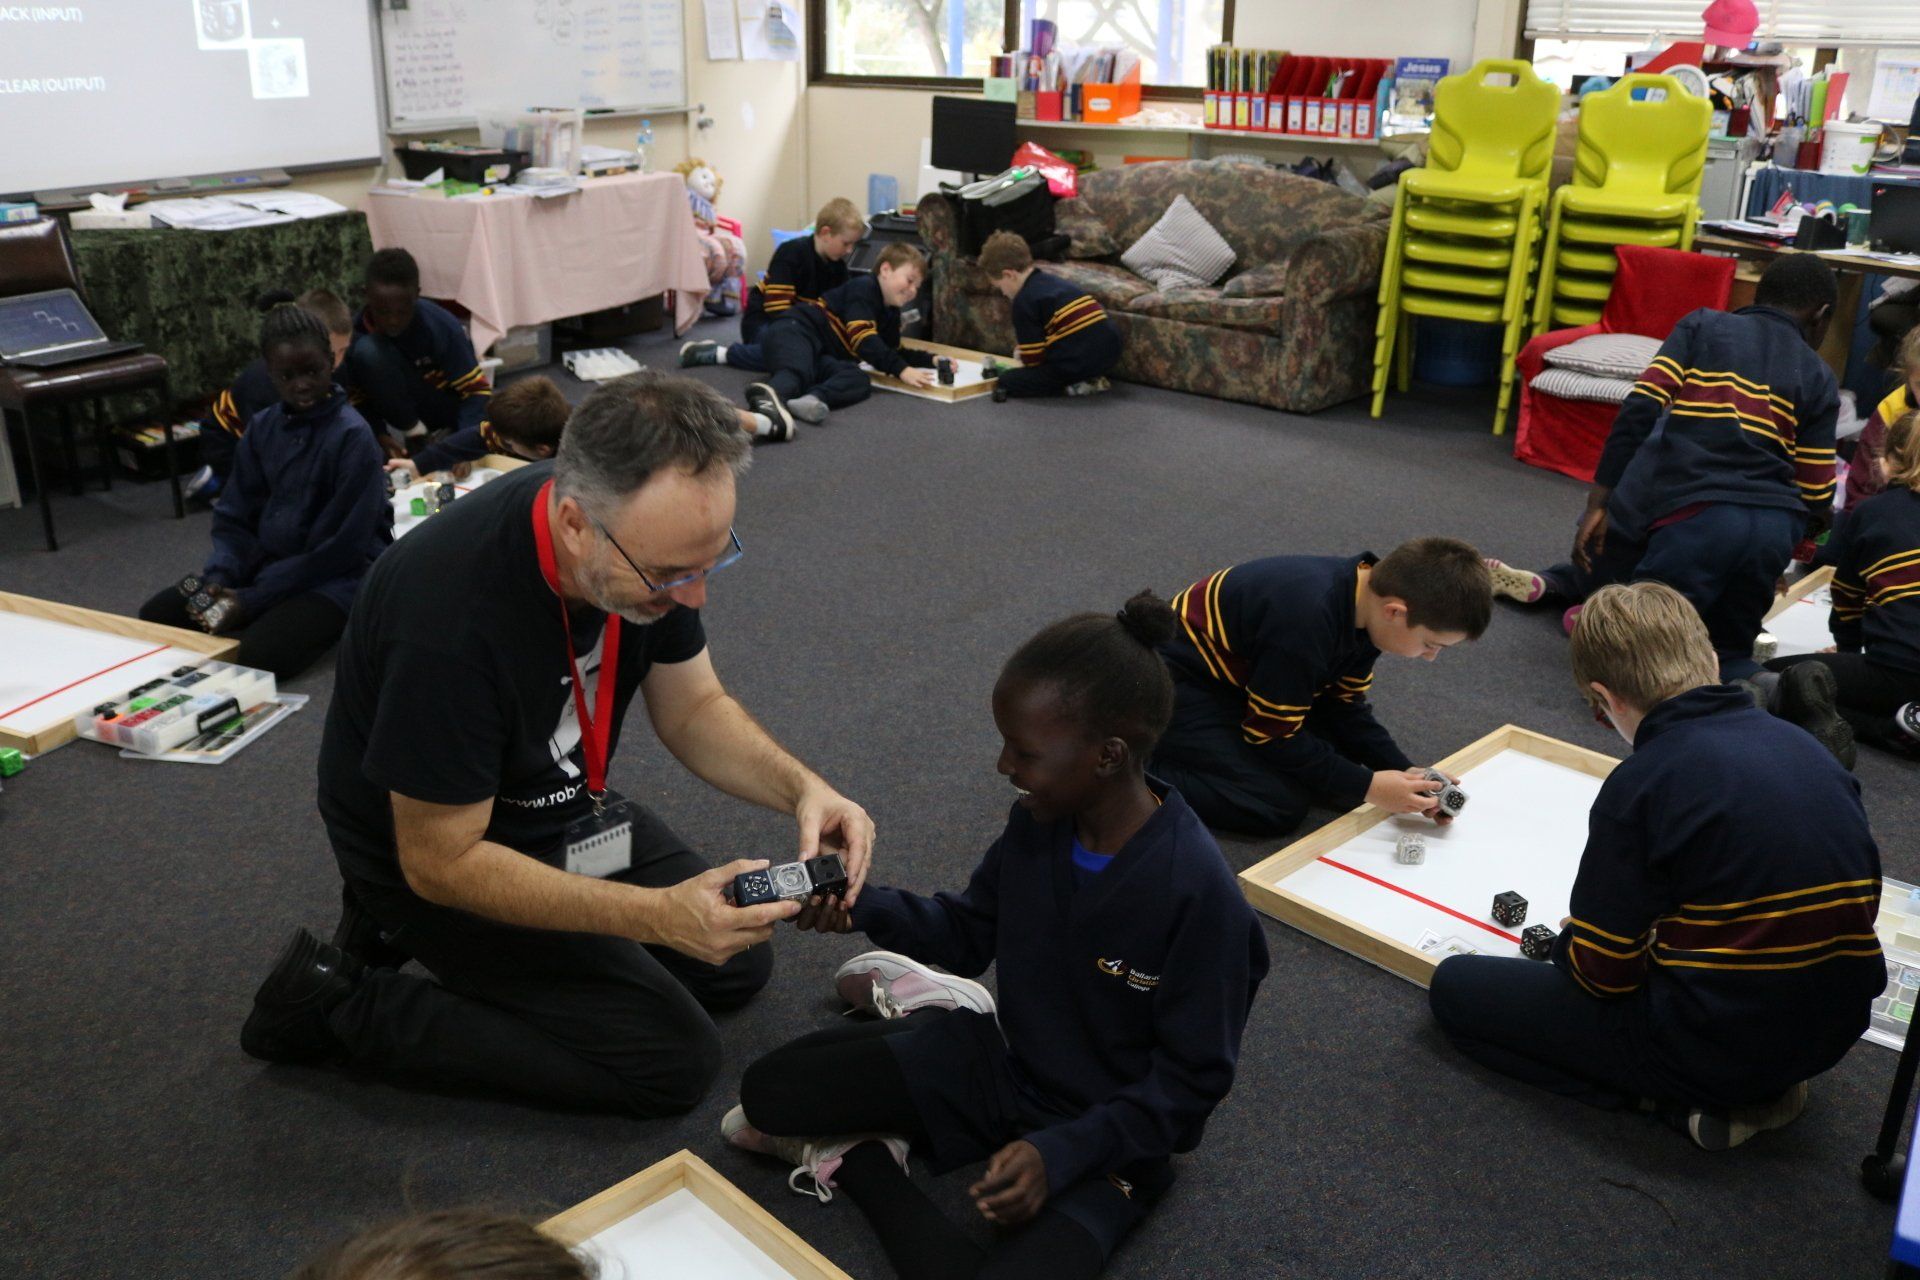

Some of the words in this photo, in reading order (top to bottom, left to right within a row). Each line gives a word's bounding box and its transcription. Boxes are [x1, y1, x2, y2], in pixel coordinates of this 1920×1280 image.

[32, 6, 84, 23] (INPUT)
[1402, 62, 1442, 74] Jesus
[41, 75, 105, 93] (OUTPUT)
